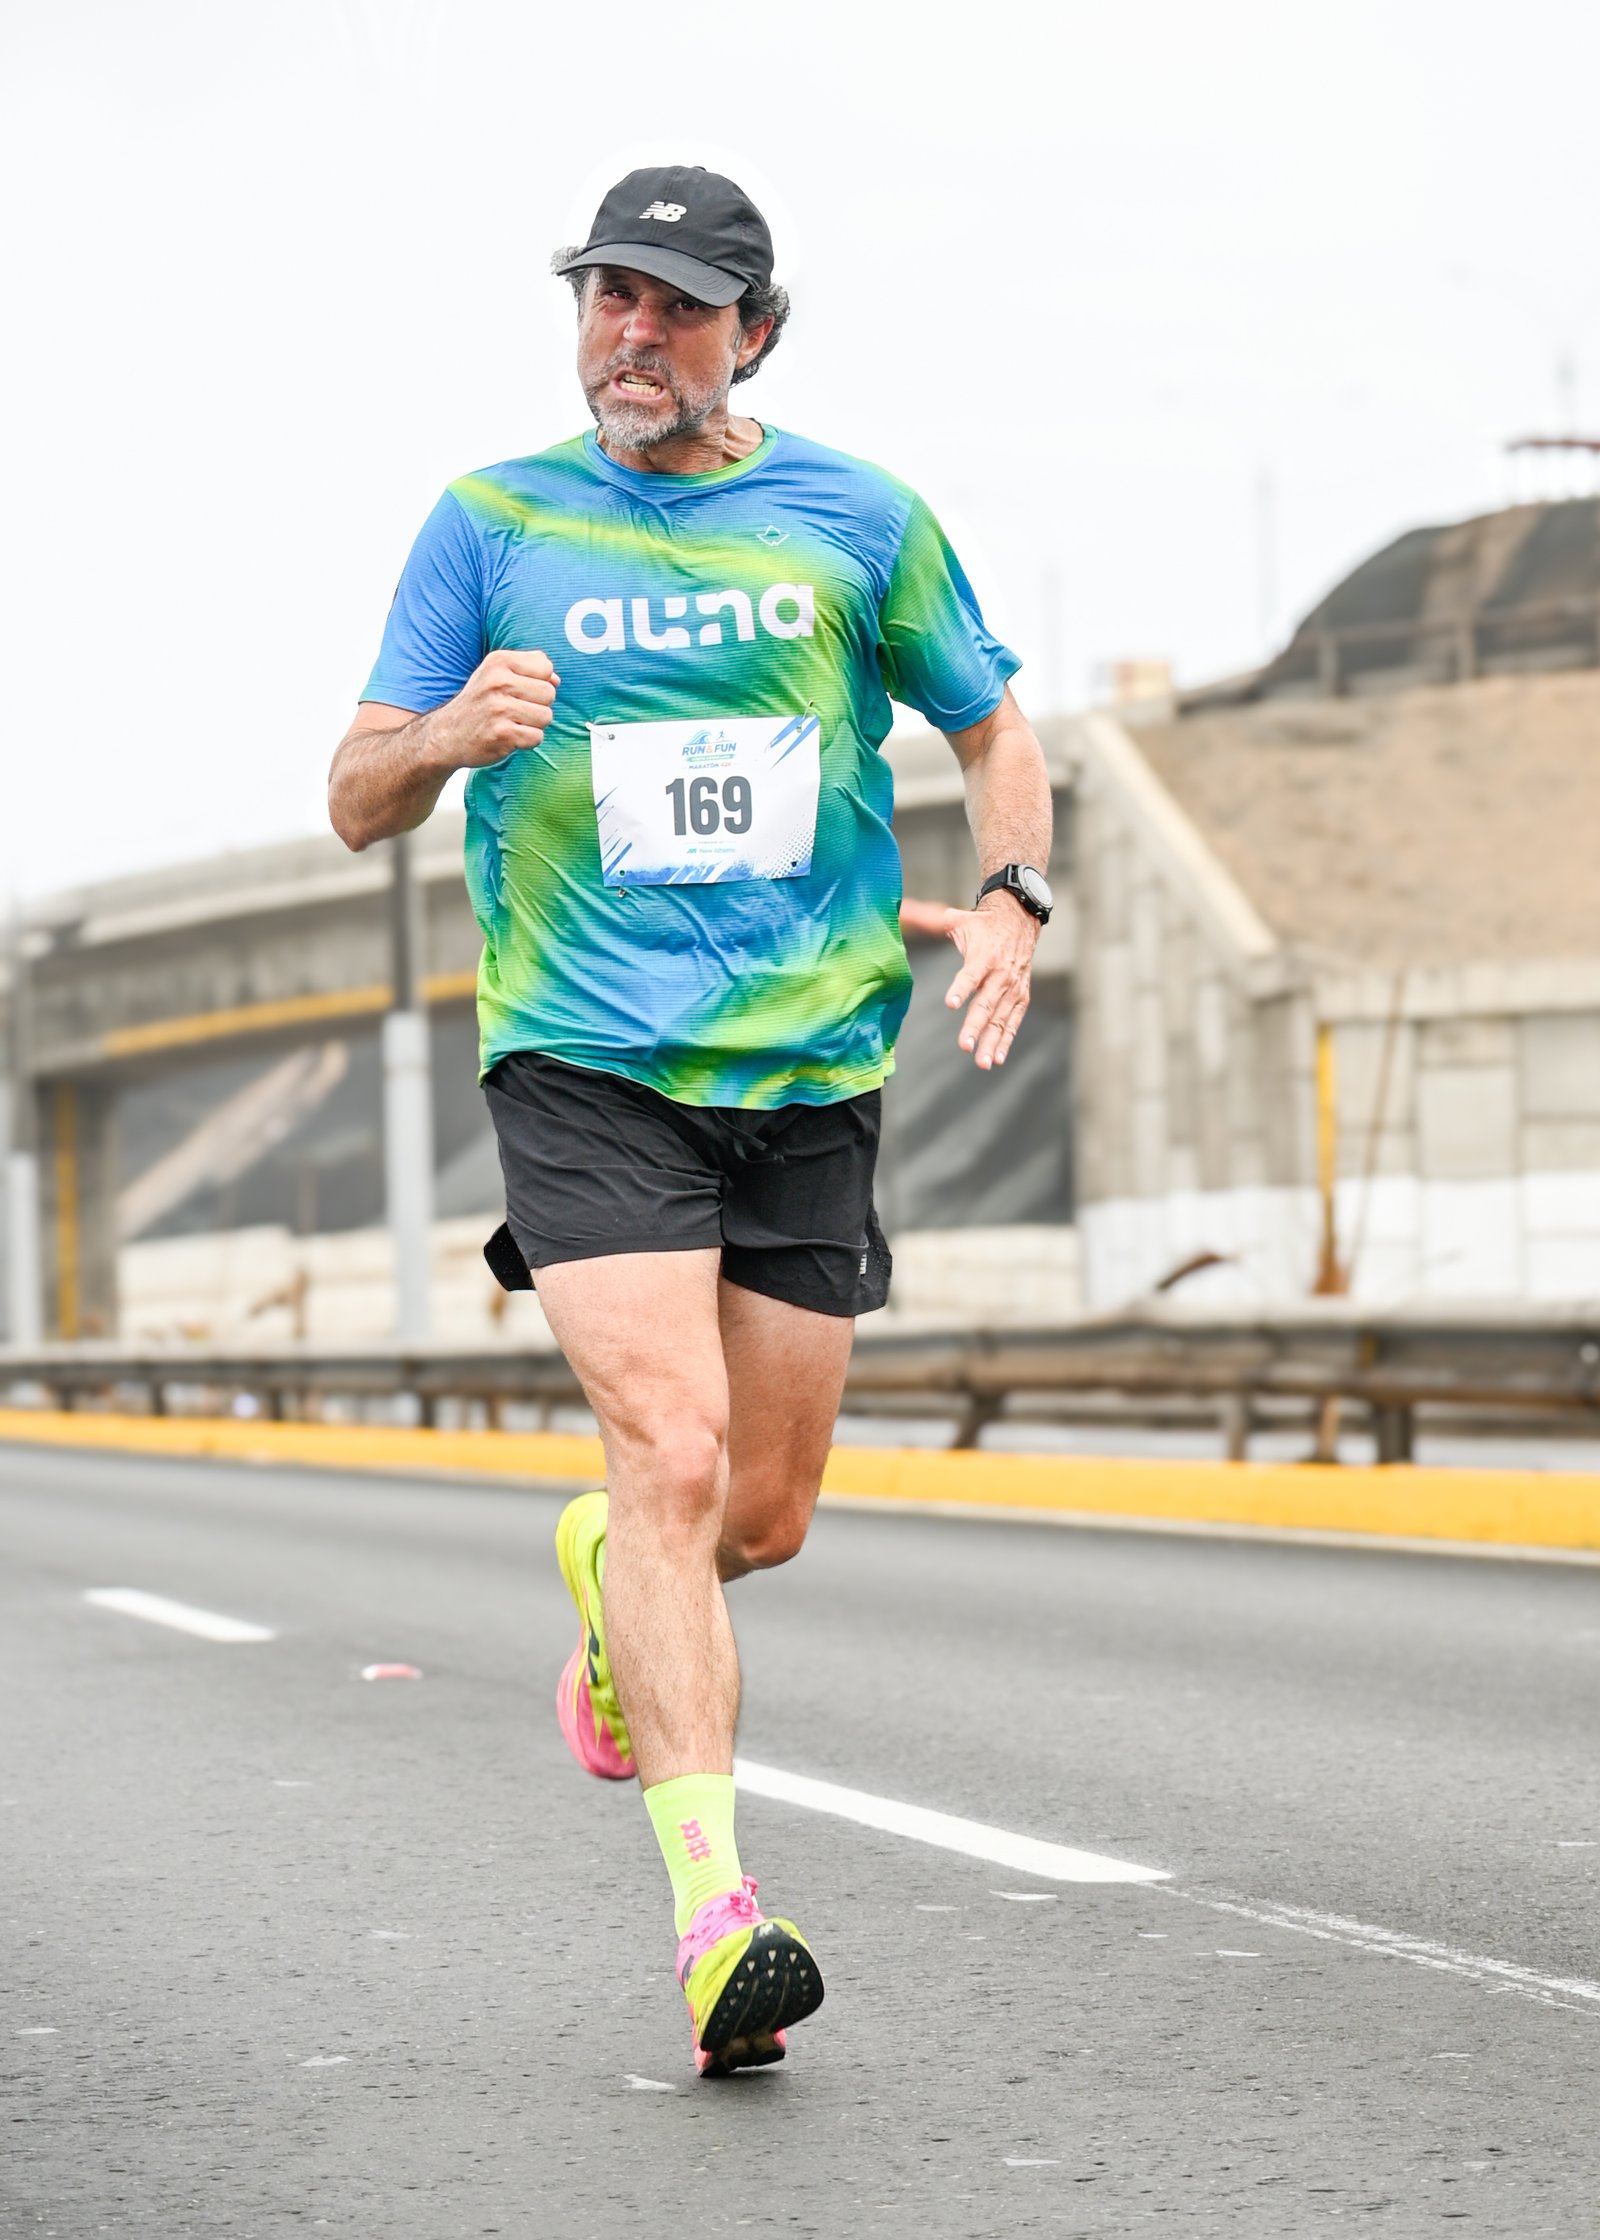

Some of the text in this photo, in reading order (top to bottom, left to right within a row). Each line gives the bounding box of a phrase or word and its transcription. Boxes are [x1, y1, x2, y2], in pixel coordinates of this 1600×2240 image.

[639, 201, 687, 222] NB
[564, 583, 815, 654] auna
[665, 775, 753, 836] 169
